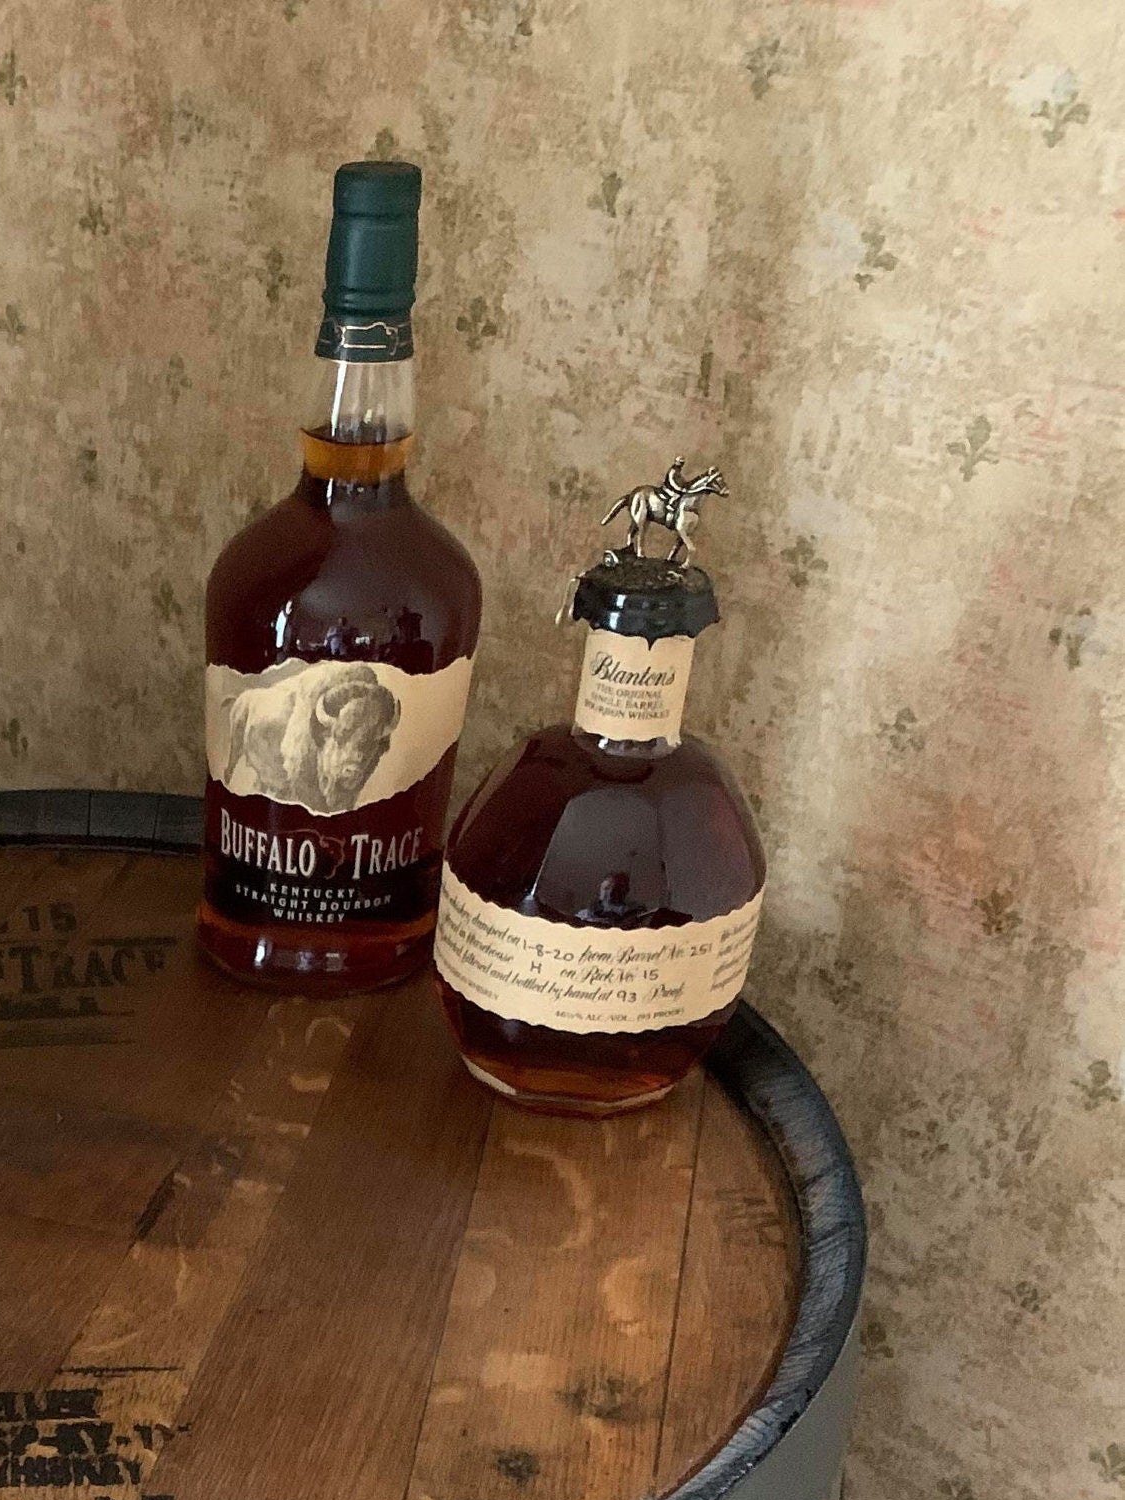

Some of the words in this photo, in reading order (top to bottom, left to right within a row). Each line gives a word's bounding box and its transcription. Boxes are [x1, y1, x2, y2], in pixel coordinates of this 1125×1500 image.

[220, 807, 317, 879] BUFFALO
[351, 826, 424, 880] TRACE
[235, 883, 308, 911] STRAIGHT
[320, 894, 391, 912] BOURBON
[270, 883, 355, 899] KENTUCKY
[273, 908, 345, 923] WHISKEY
[523, 939, 575, 962] 1-8-20
[530, 961, 542, 974] H
[643, 968, 659, 981] 15
[617, 989, 637, 1003] 93
